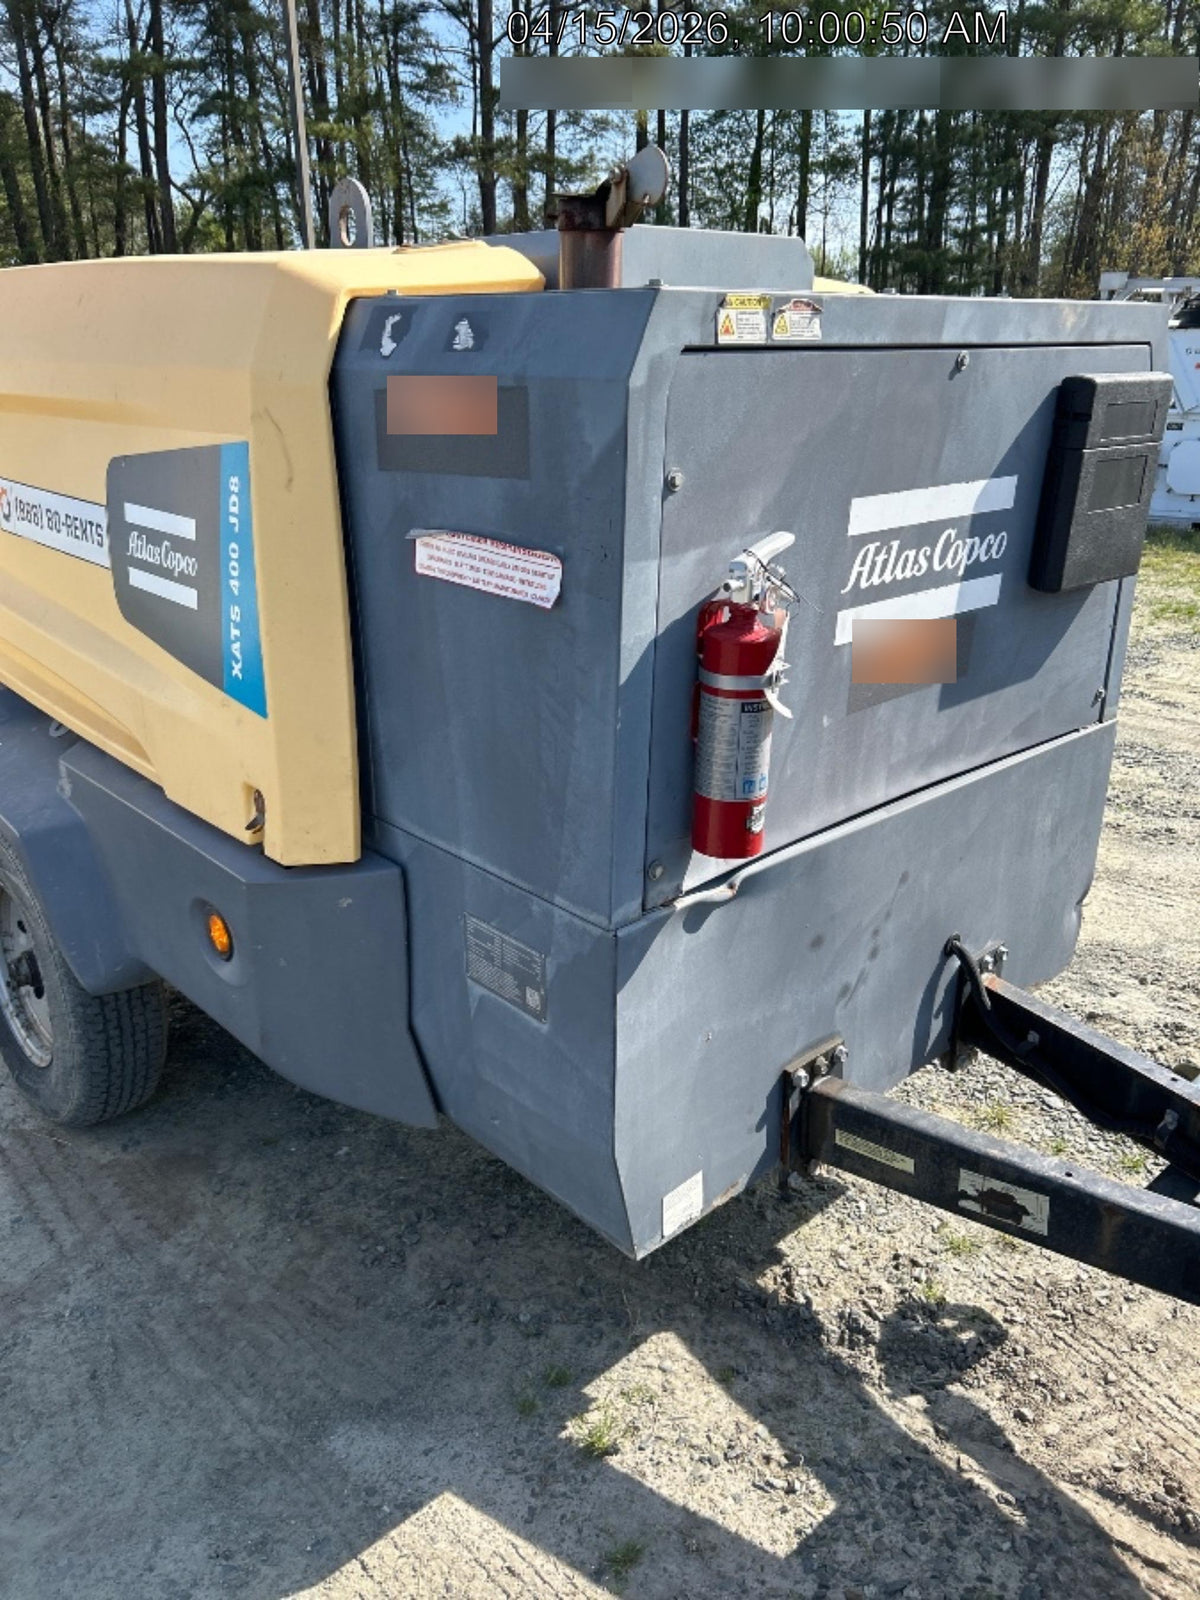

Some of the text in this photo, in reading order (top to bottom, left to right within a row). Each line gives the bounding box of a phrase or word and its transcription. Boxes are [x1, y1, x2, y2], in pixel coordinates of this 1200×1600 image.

[15, 497, 43, 530] (888)
[127, 531, 198, 577] Atlas Copco
[228, 475, 243, 680] XATS 400 JD8
[841, 528, 1007, 594] Atlas Copco
